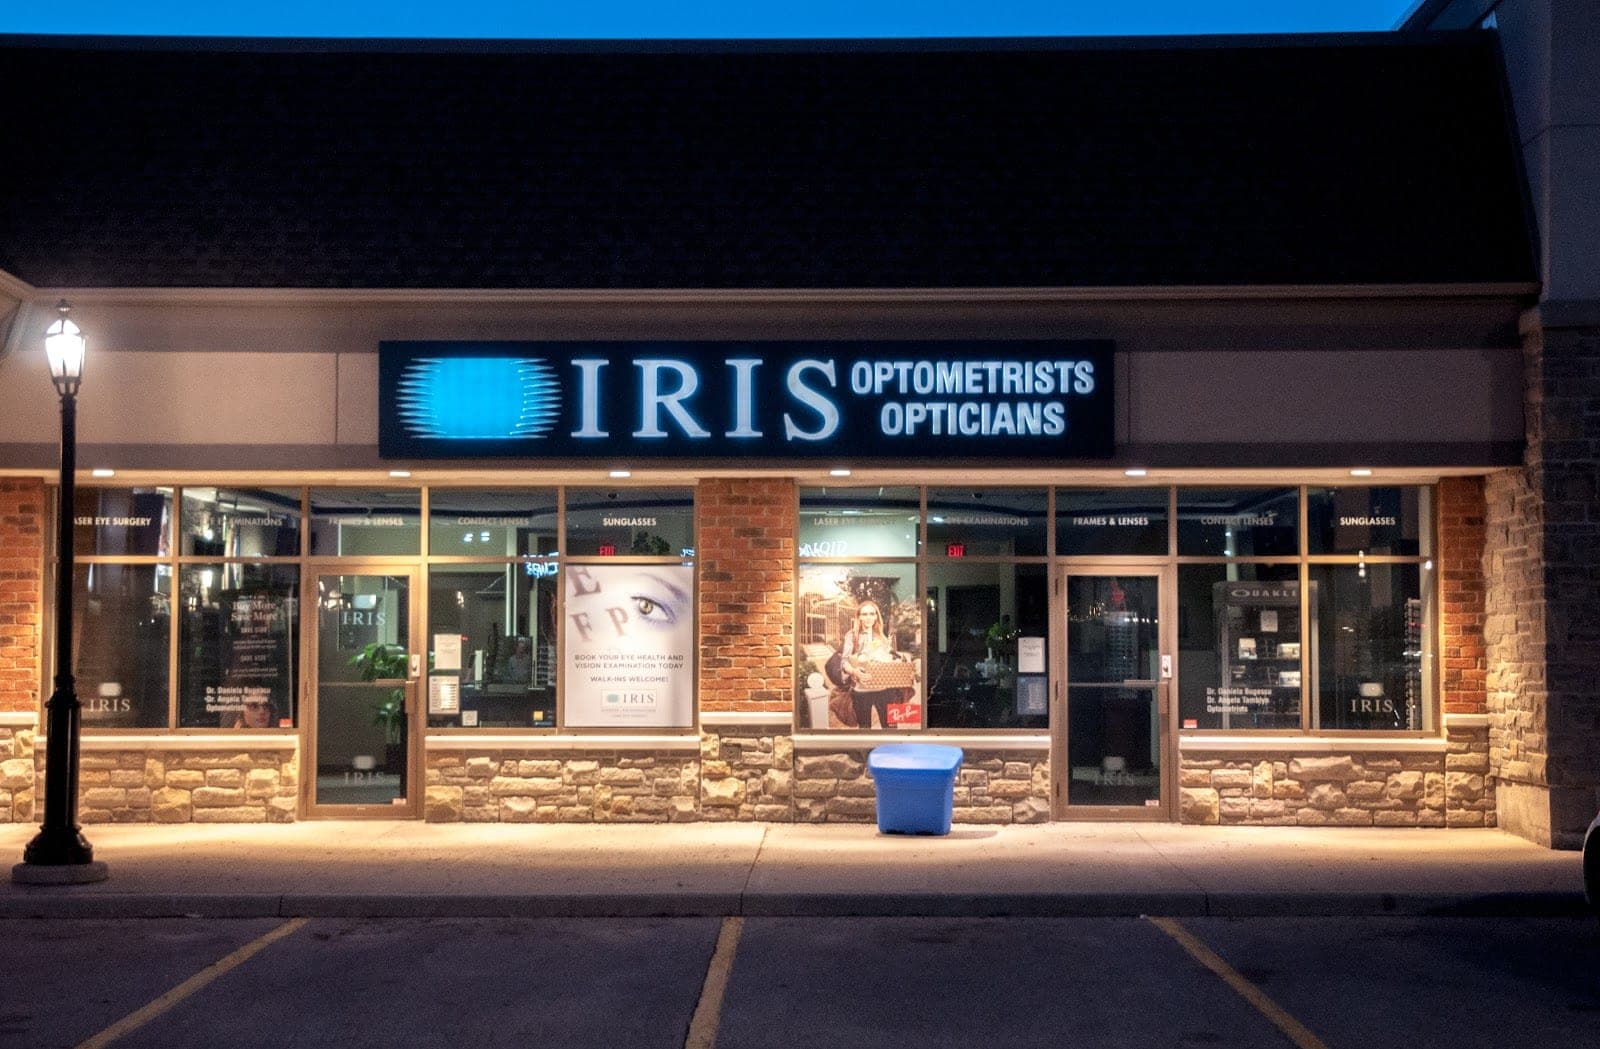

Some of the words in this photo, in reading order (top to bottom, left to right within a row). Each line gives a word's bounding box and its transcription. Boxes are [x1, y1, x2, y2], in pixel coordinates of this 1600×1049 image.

[851, 360, 1095, 394] OPTOMETRISTS
[570, 357, 840, 442] IRIS
[880, 402, 1065, 435] OPTICIANS
[74, 516, 92, 526] ASER
[95, 516, 109, 526] EYE
[112, 516, 152, 526] SURGERY
[372, 517, 404, 526] LENSES
[457, 517, 497, 526] CONTACT
[602, 517, 657, 526] SUNGLASSES
[813, 517, 838, 526] LASER
[1073, 517, 1107, 526] FRAMES
[1109, 517, 1116, 526] &
[1118, 517, 1149, 526] LENSES
[1243, 516, 1274, 526] LENSES
[1340, 517, 1396, 526] SUNGLASSES
[343, 611, 386, 625] IRIS
[623, 693, 655, 704] IRIS
[90, 699, 131, 712] IRIS
[1351, 699, 1393, 712] IRIS
